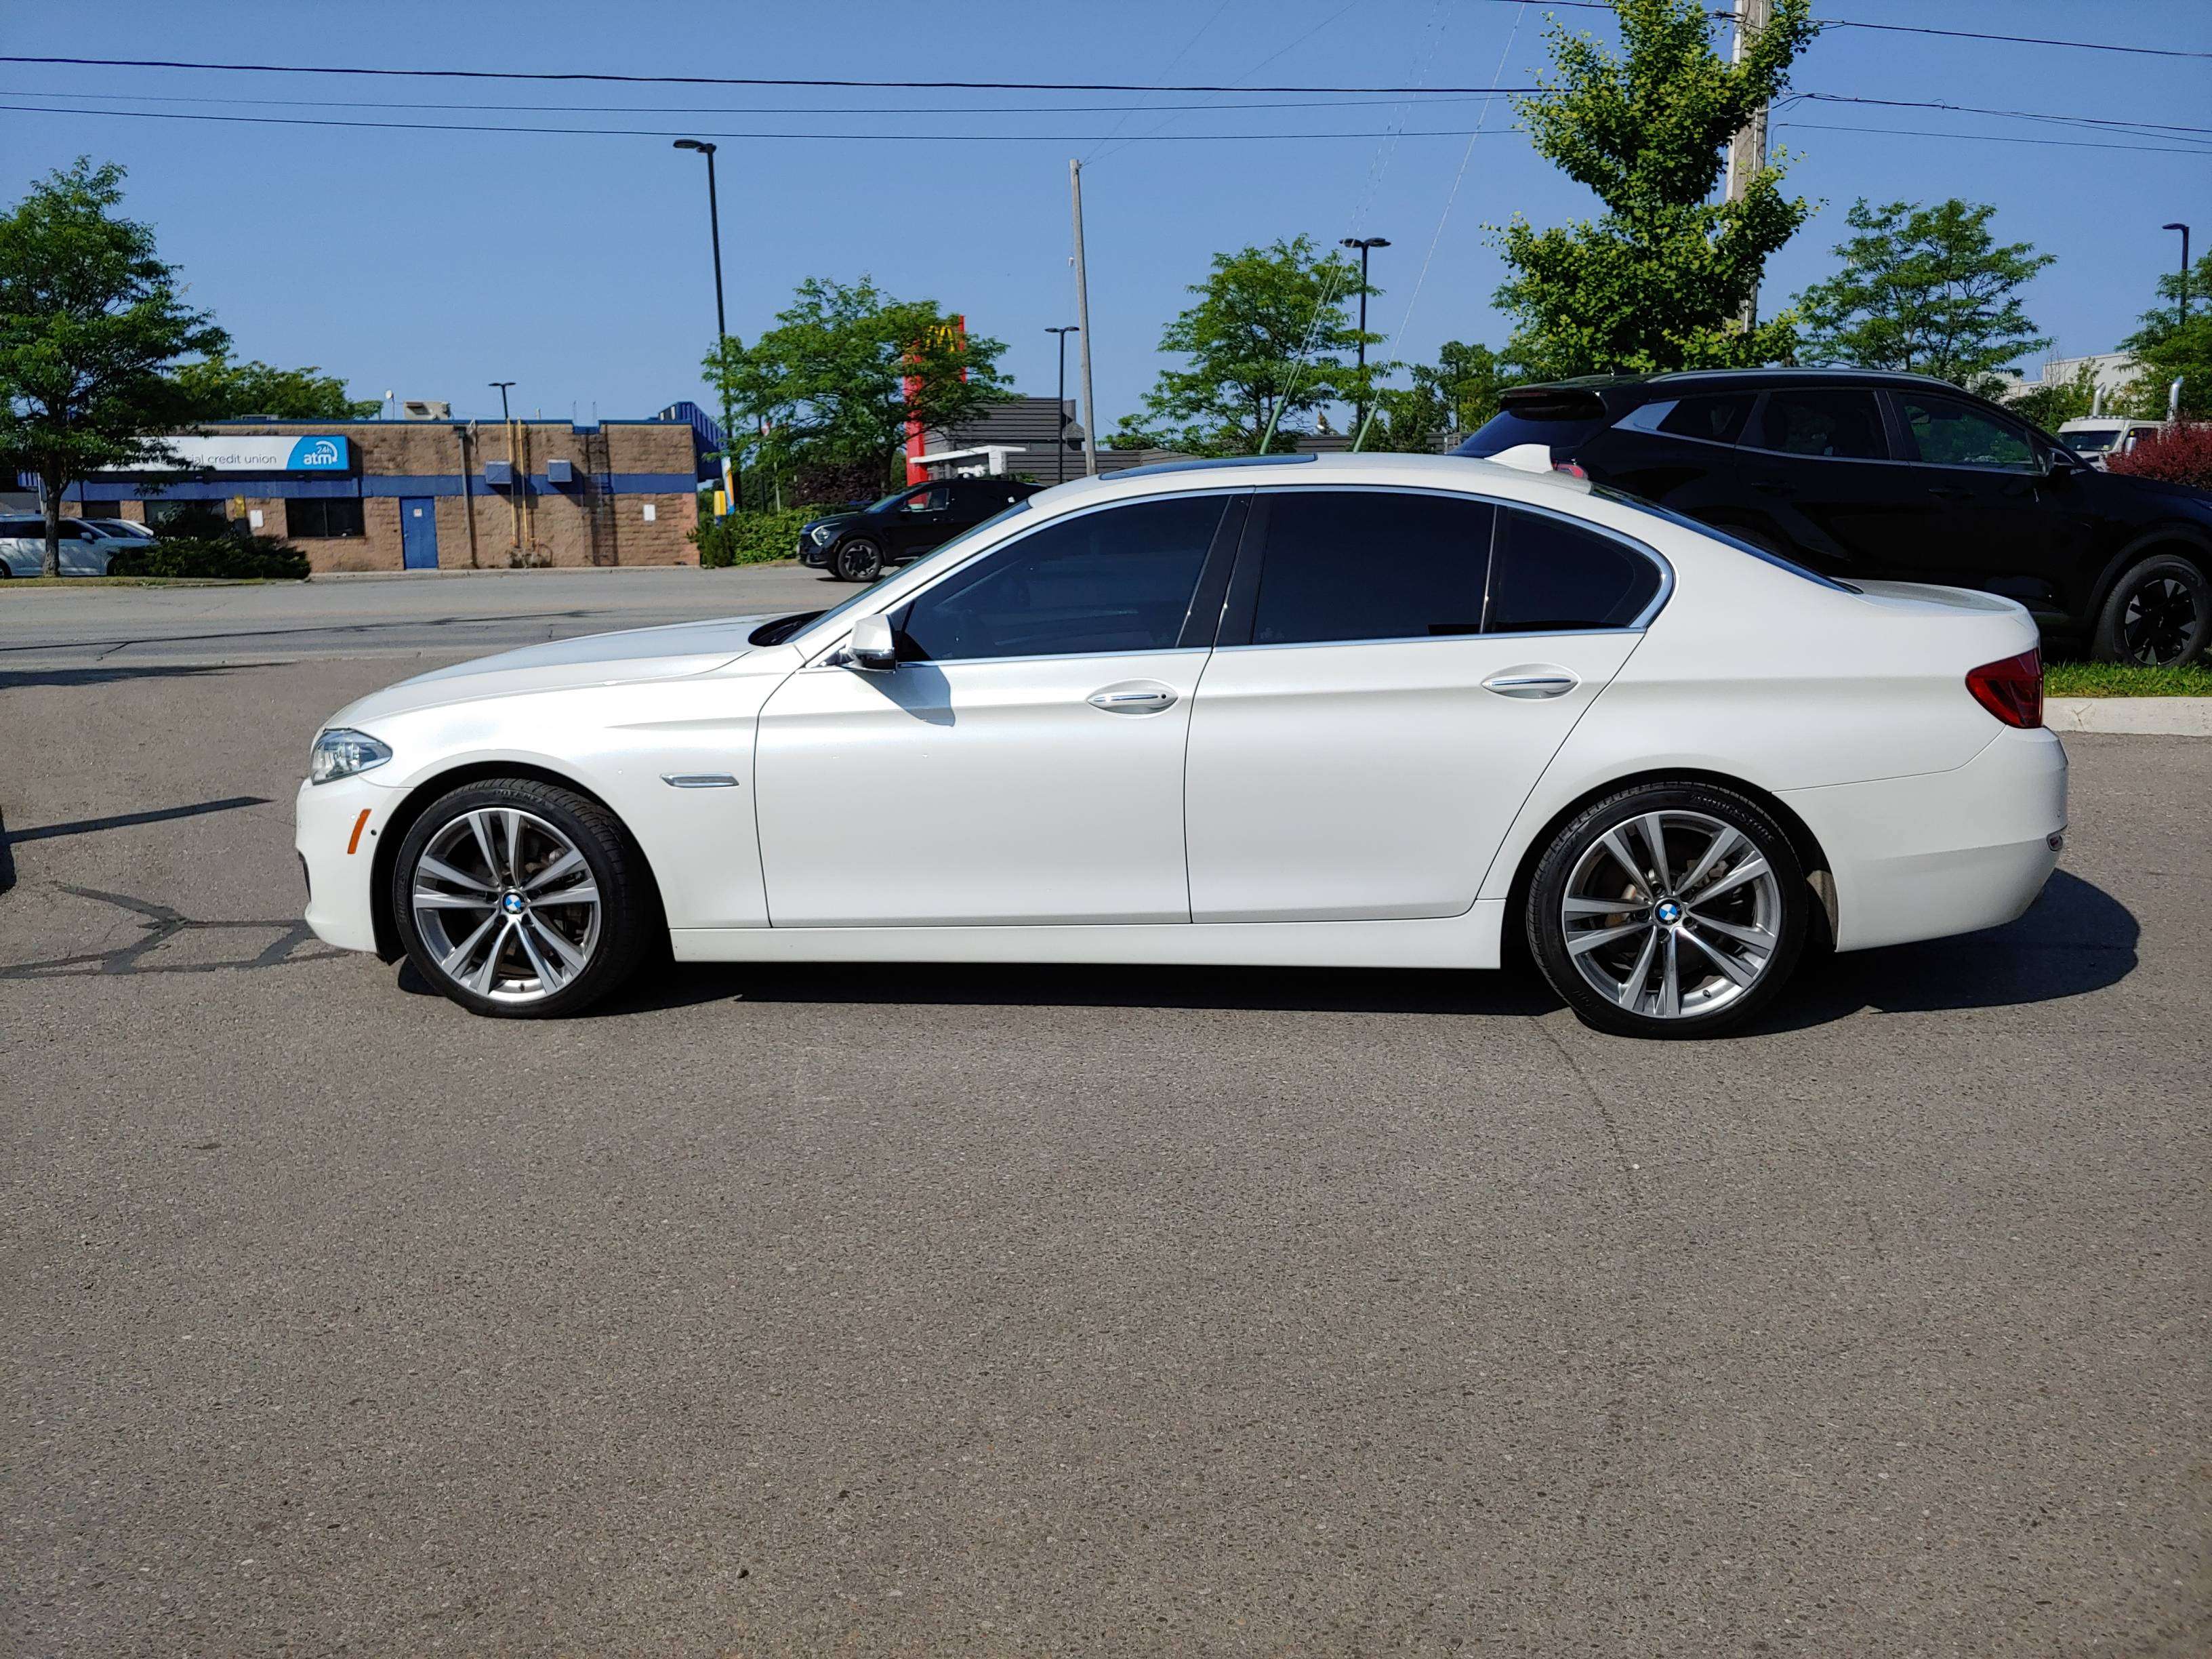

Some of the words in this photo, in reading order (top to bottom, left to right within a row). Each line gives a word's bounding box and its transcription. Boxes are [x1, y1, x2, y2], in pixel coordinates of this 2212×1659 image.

[207, 453, 241, 464] credit
[245, 453, 277, 464] union
[304, 452, 332, 465] atm
